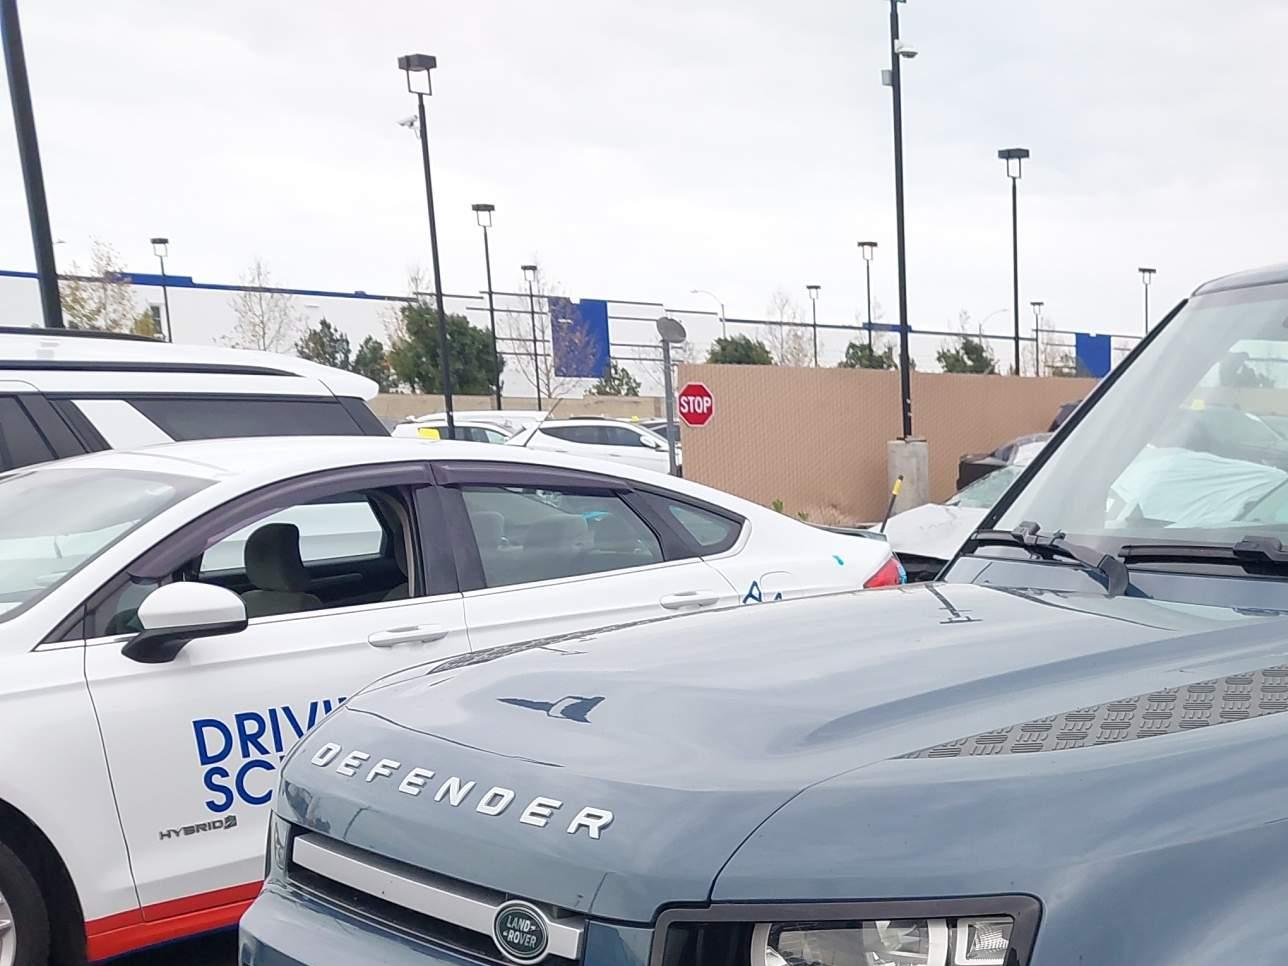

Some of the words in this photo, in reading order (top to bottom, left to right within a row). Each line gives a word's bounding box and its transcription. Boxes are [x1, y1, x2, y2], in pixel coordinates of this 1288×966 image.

[680, 396, 711, 413] STOP
[193, 697, 346, 766] DRIV
[203, 756, 285, 813] SC
[311, 742, 614, 840] DEFENDER
[159, 820, 224, 841] HYBRID
[506, 915, 531, 932] LAND
[507, 930, 537, 948] ROVER
